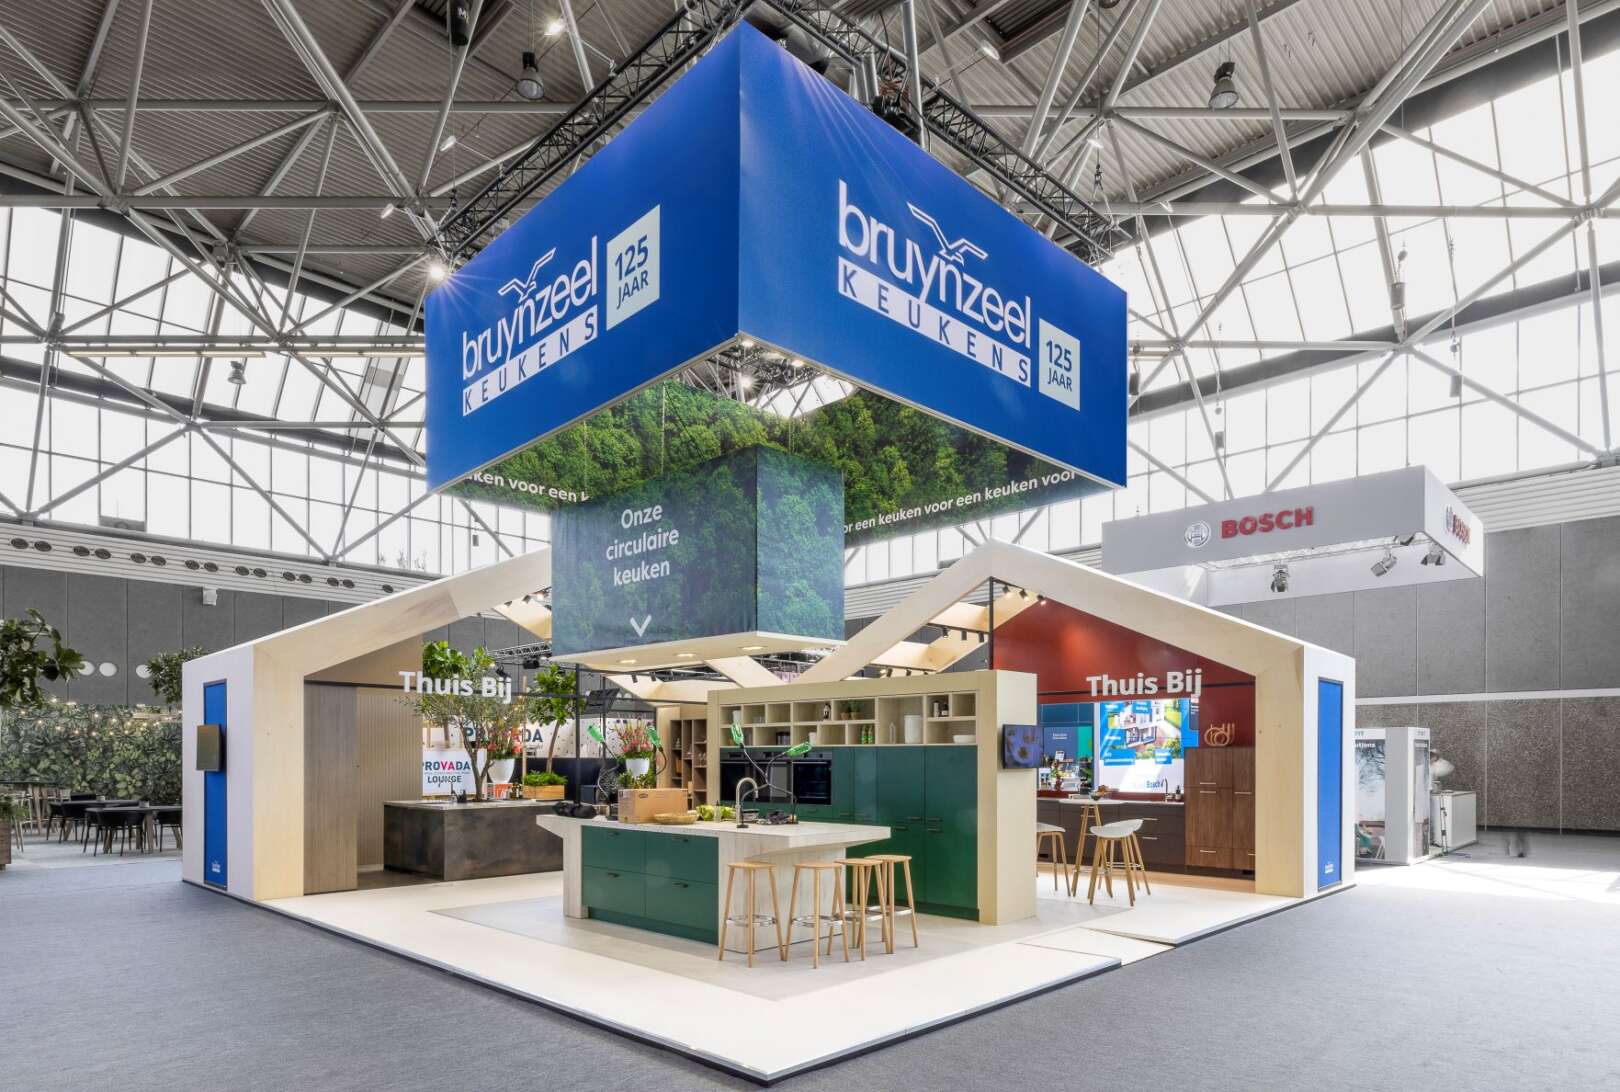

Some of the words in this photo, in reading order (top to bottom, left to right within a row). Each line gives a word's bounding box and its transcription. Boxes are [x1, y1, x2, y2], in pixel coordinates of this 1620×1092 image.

[614, 235, 649, 281] 125
[838, 178, 1031, 349] bruynzeel
[617, 270, 649, 309] JAAR
[462, 235, 598, 380] bruynzeel
[842, 270, 1028, 382] KEUKENS
[463, 311, 597, 412] KEUKENS
[1046, 340, 1072, 372] 125
[1048, 366, 1072, 392] JAAR
[508, 478, 545, 495] voor
[548, 488, 577, 502] een
[855, 518, 876, 531] een
[878, 507, 922, 526] keuken
[924, 498, 954, 515] voor
[956, 492, 981, 507] een
[984, 477, 1038, 501] keuken
[621, 504, 664, 529] Onze
[1221, 506, 1314, 539] BOSCH
[605, 529, 679, 561] circulaire
[613, 559, 670, 587] keuken
[399, 671, 475, 697] Thuis
[481, 676, 511, 704] Bij
[1086, 673, 1158, 697] Thuis
[1166, 668, 1203, 696] Bij
[422, 761, 471, 771] ROVADA
[427, 775, 462, 784] LOUNGE
